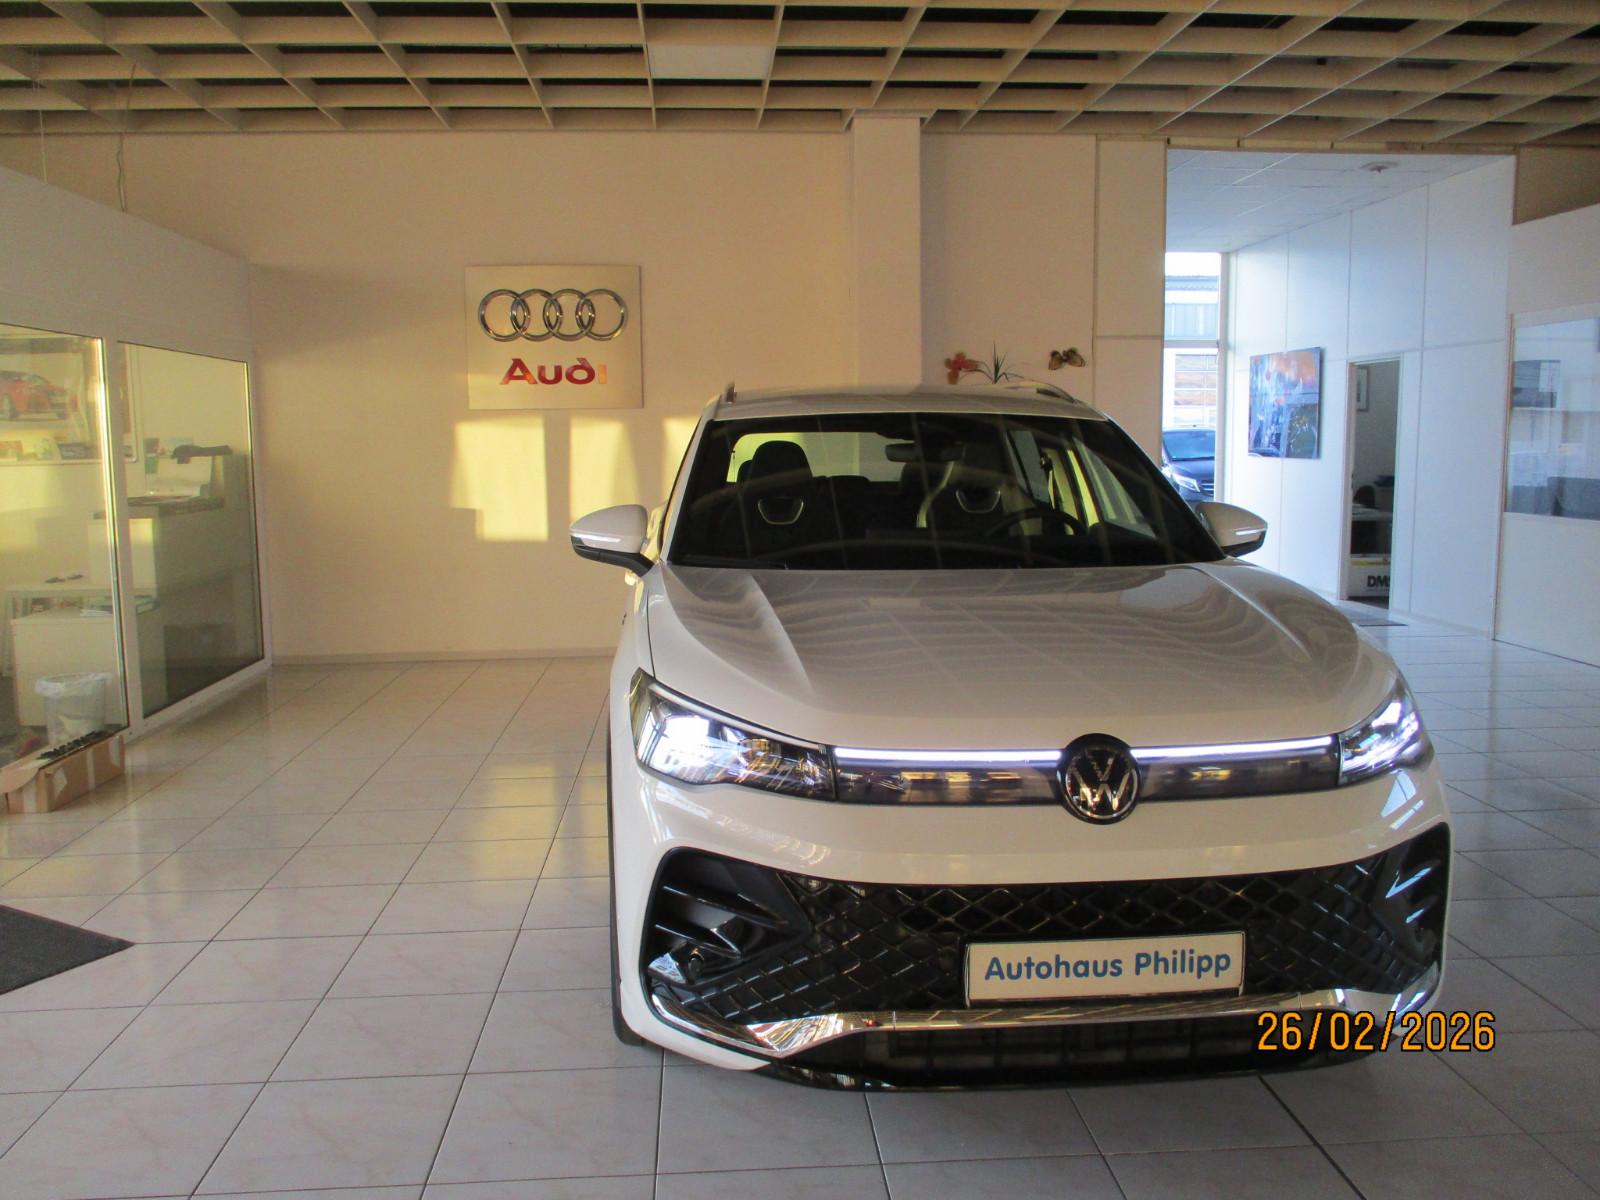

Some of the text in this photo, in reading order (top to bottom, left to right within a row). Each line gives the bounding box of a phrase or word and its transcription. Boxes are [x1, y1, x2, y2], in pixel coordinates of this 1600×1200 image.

[500, 357, 607, 385] Audi
[1367, 575, 1390, 587] DM
[1068, 747, 1135, 812] VW
[984, 949, 1231, 981] Autohaus Philipp
